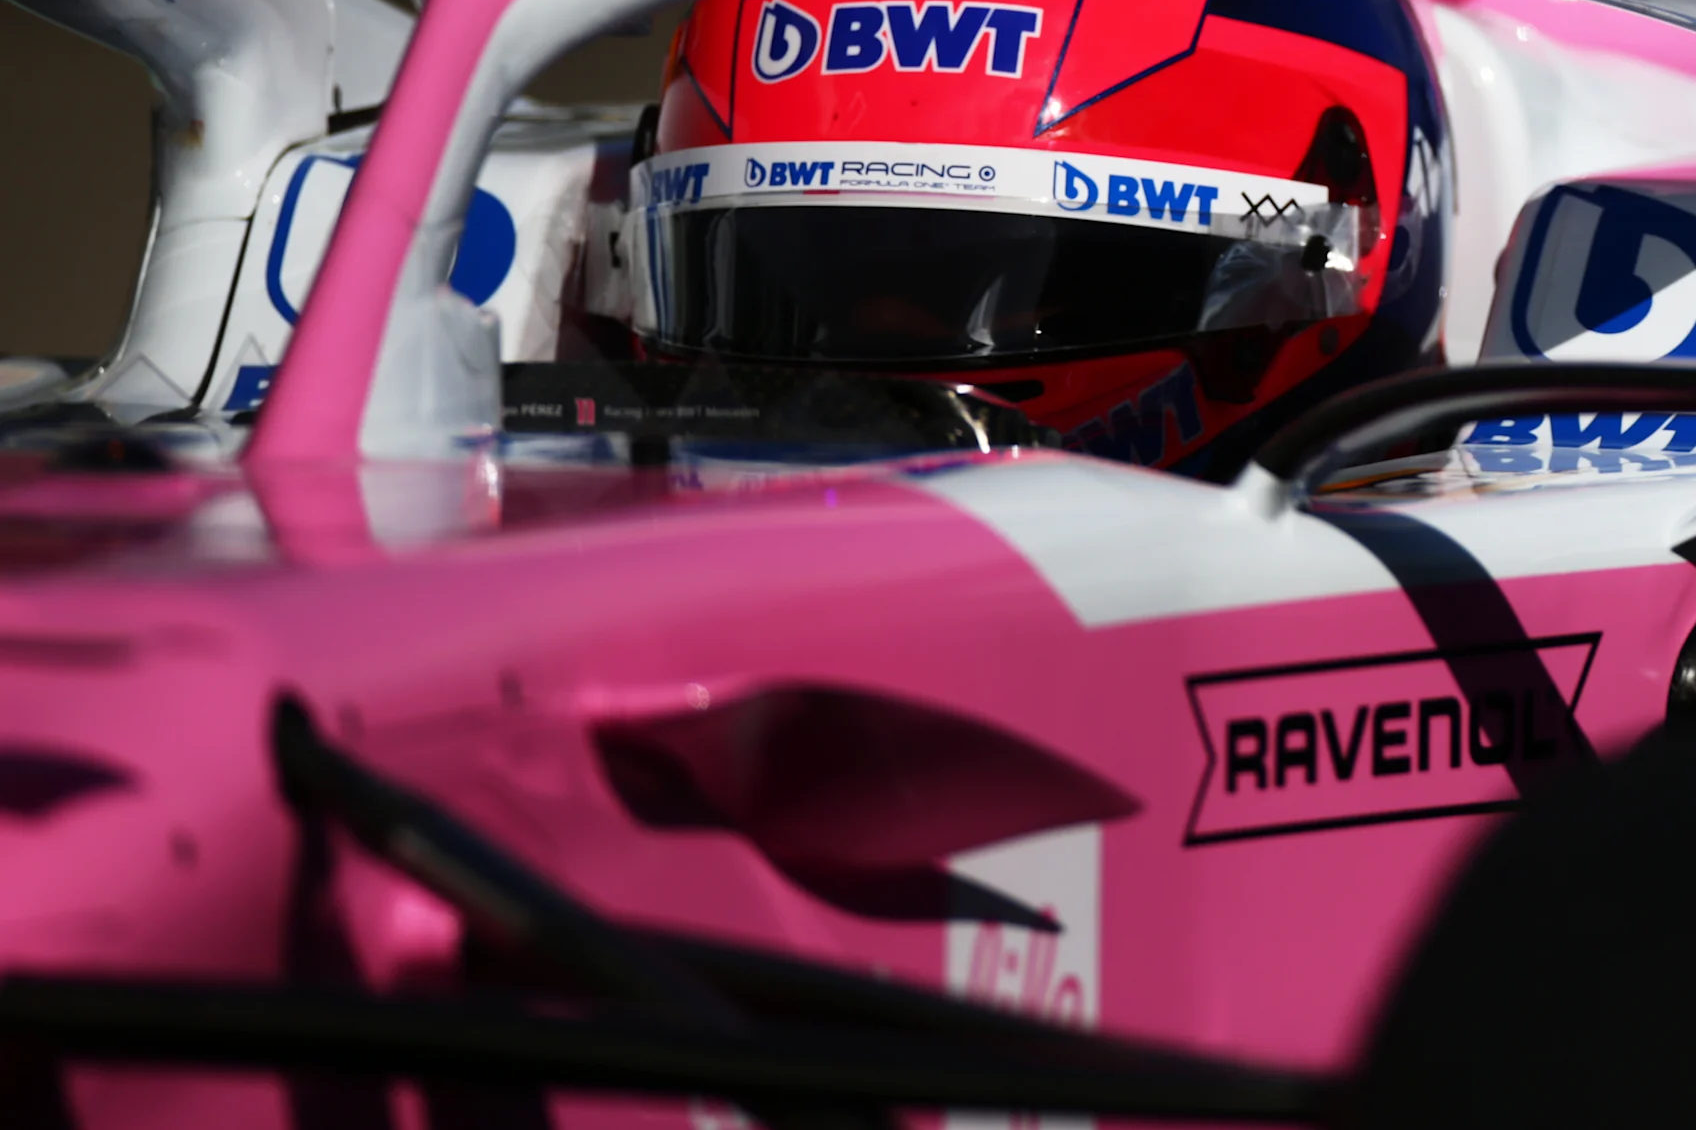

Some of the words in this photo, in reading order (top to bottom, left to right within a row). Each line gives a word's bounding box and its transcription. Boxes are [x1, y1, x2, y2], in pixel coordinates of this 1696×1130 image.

[821, 1, 1044, 79] BWT
[769, 161, 834, 186] BWT
[841, 161, 972, 179] RACING
[839, 178, 910, 188] FORMULA
[955, 182, 996, 191] TEAM
[1107, 174, 1219, 226] BWT
[1061, 359, 1203, 466] WT
[1224, 689, 1557, 794] RAVENOL
